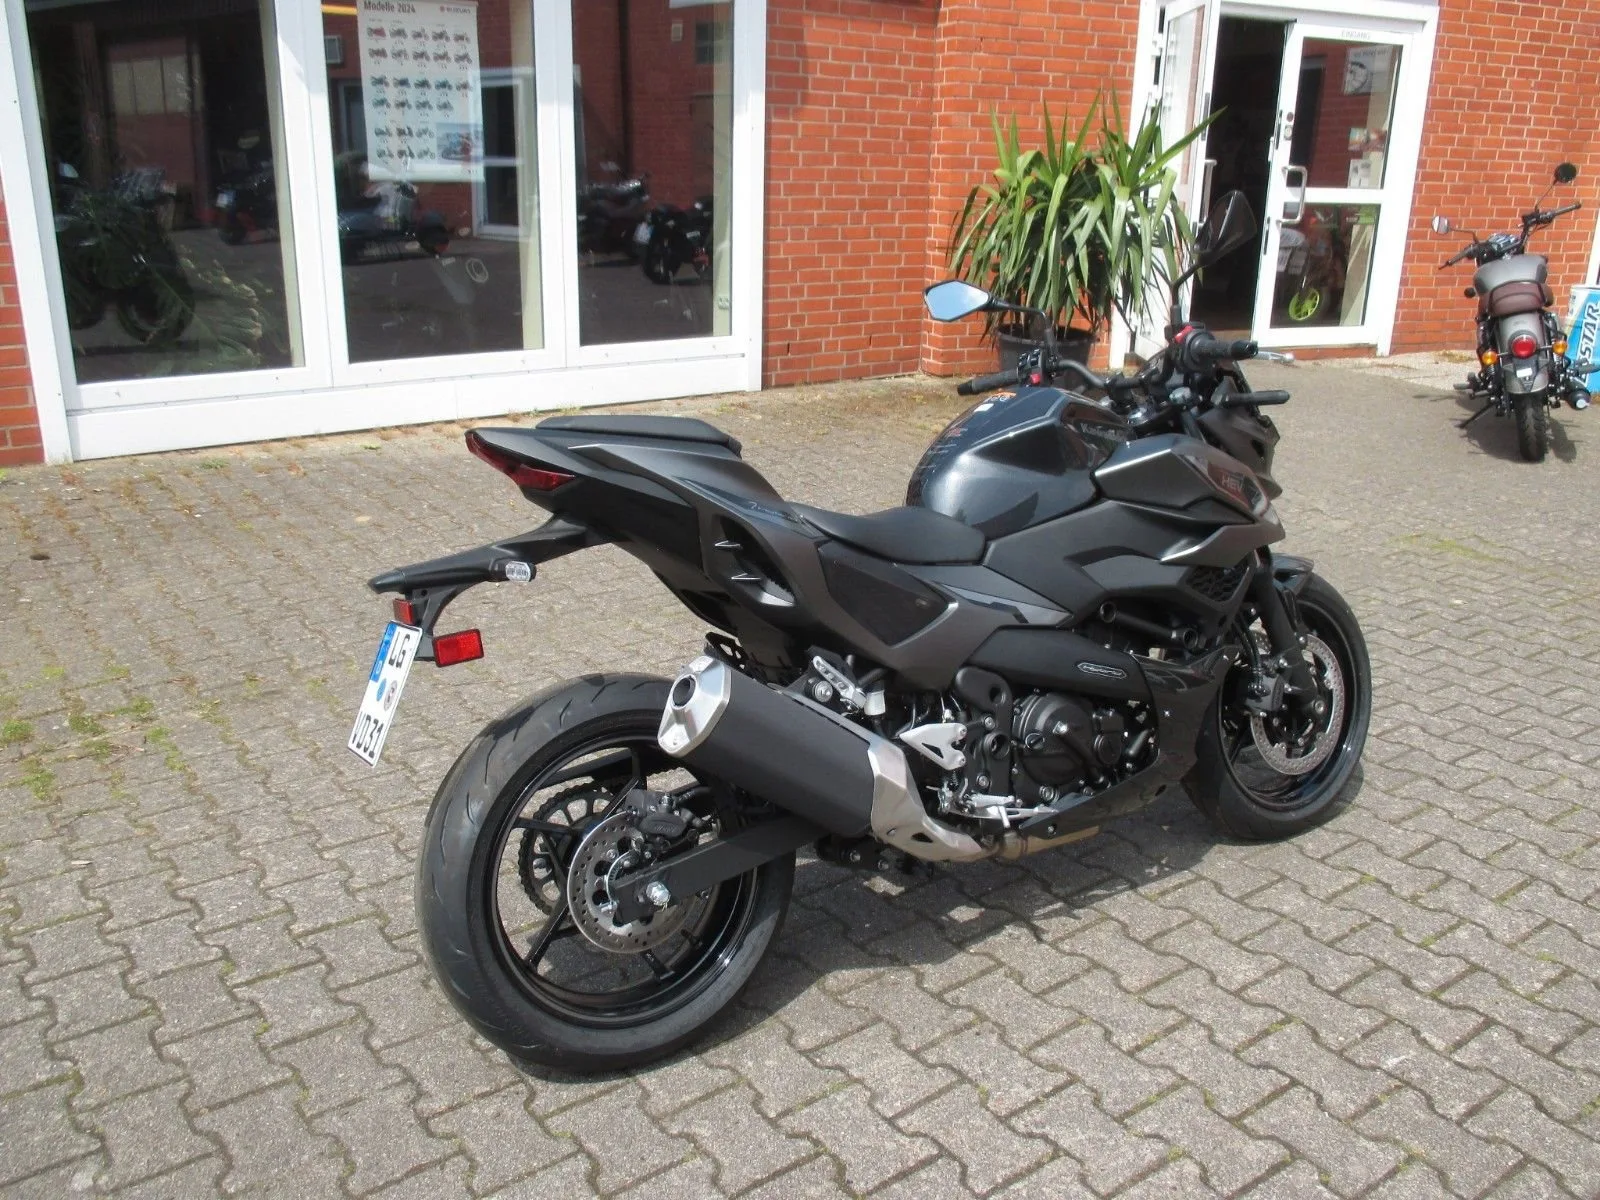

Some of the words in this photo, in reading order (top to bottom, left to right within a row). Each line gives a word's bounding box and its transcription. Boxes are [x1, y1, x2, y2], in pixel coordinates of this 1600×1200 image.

[364, 1, 394, 12] Modelle
[397, 3, 416, 13] 2024
[1576, 302, 1599, 385] STAR
[388, 631, 411, 668] LG
